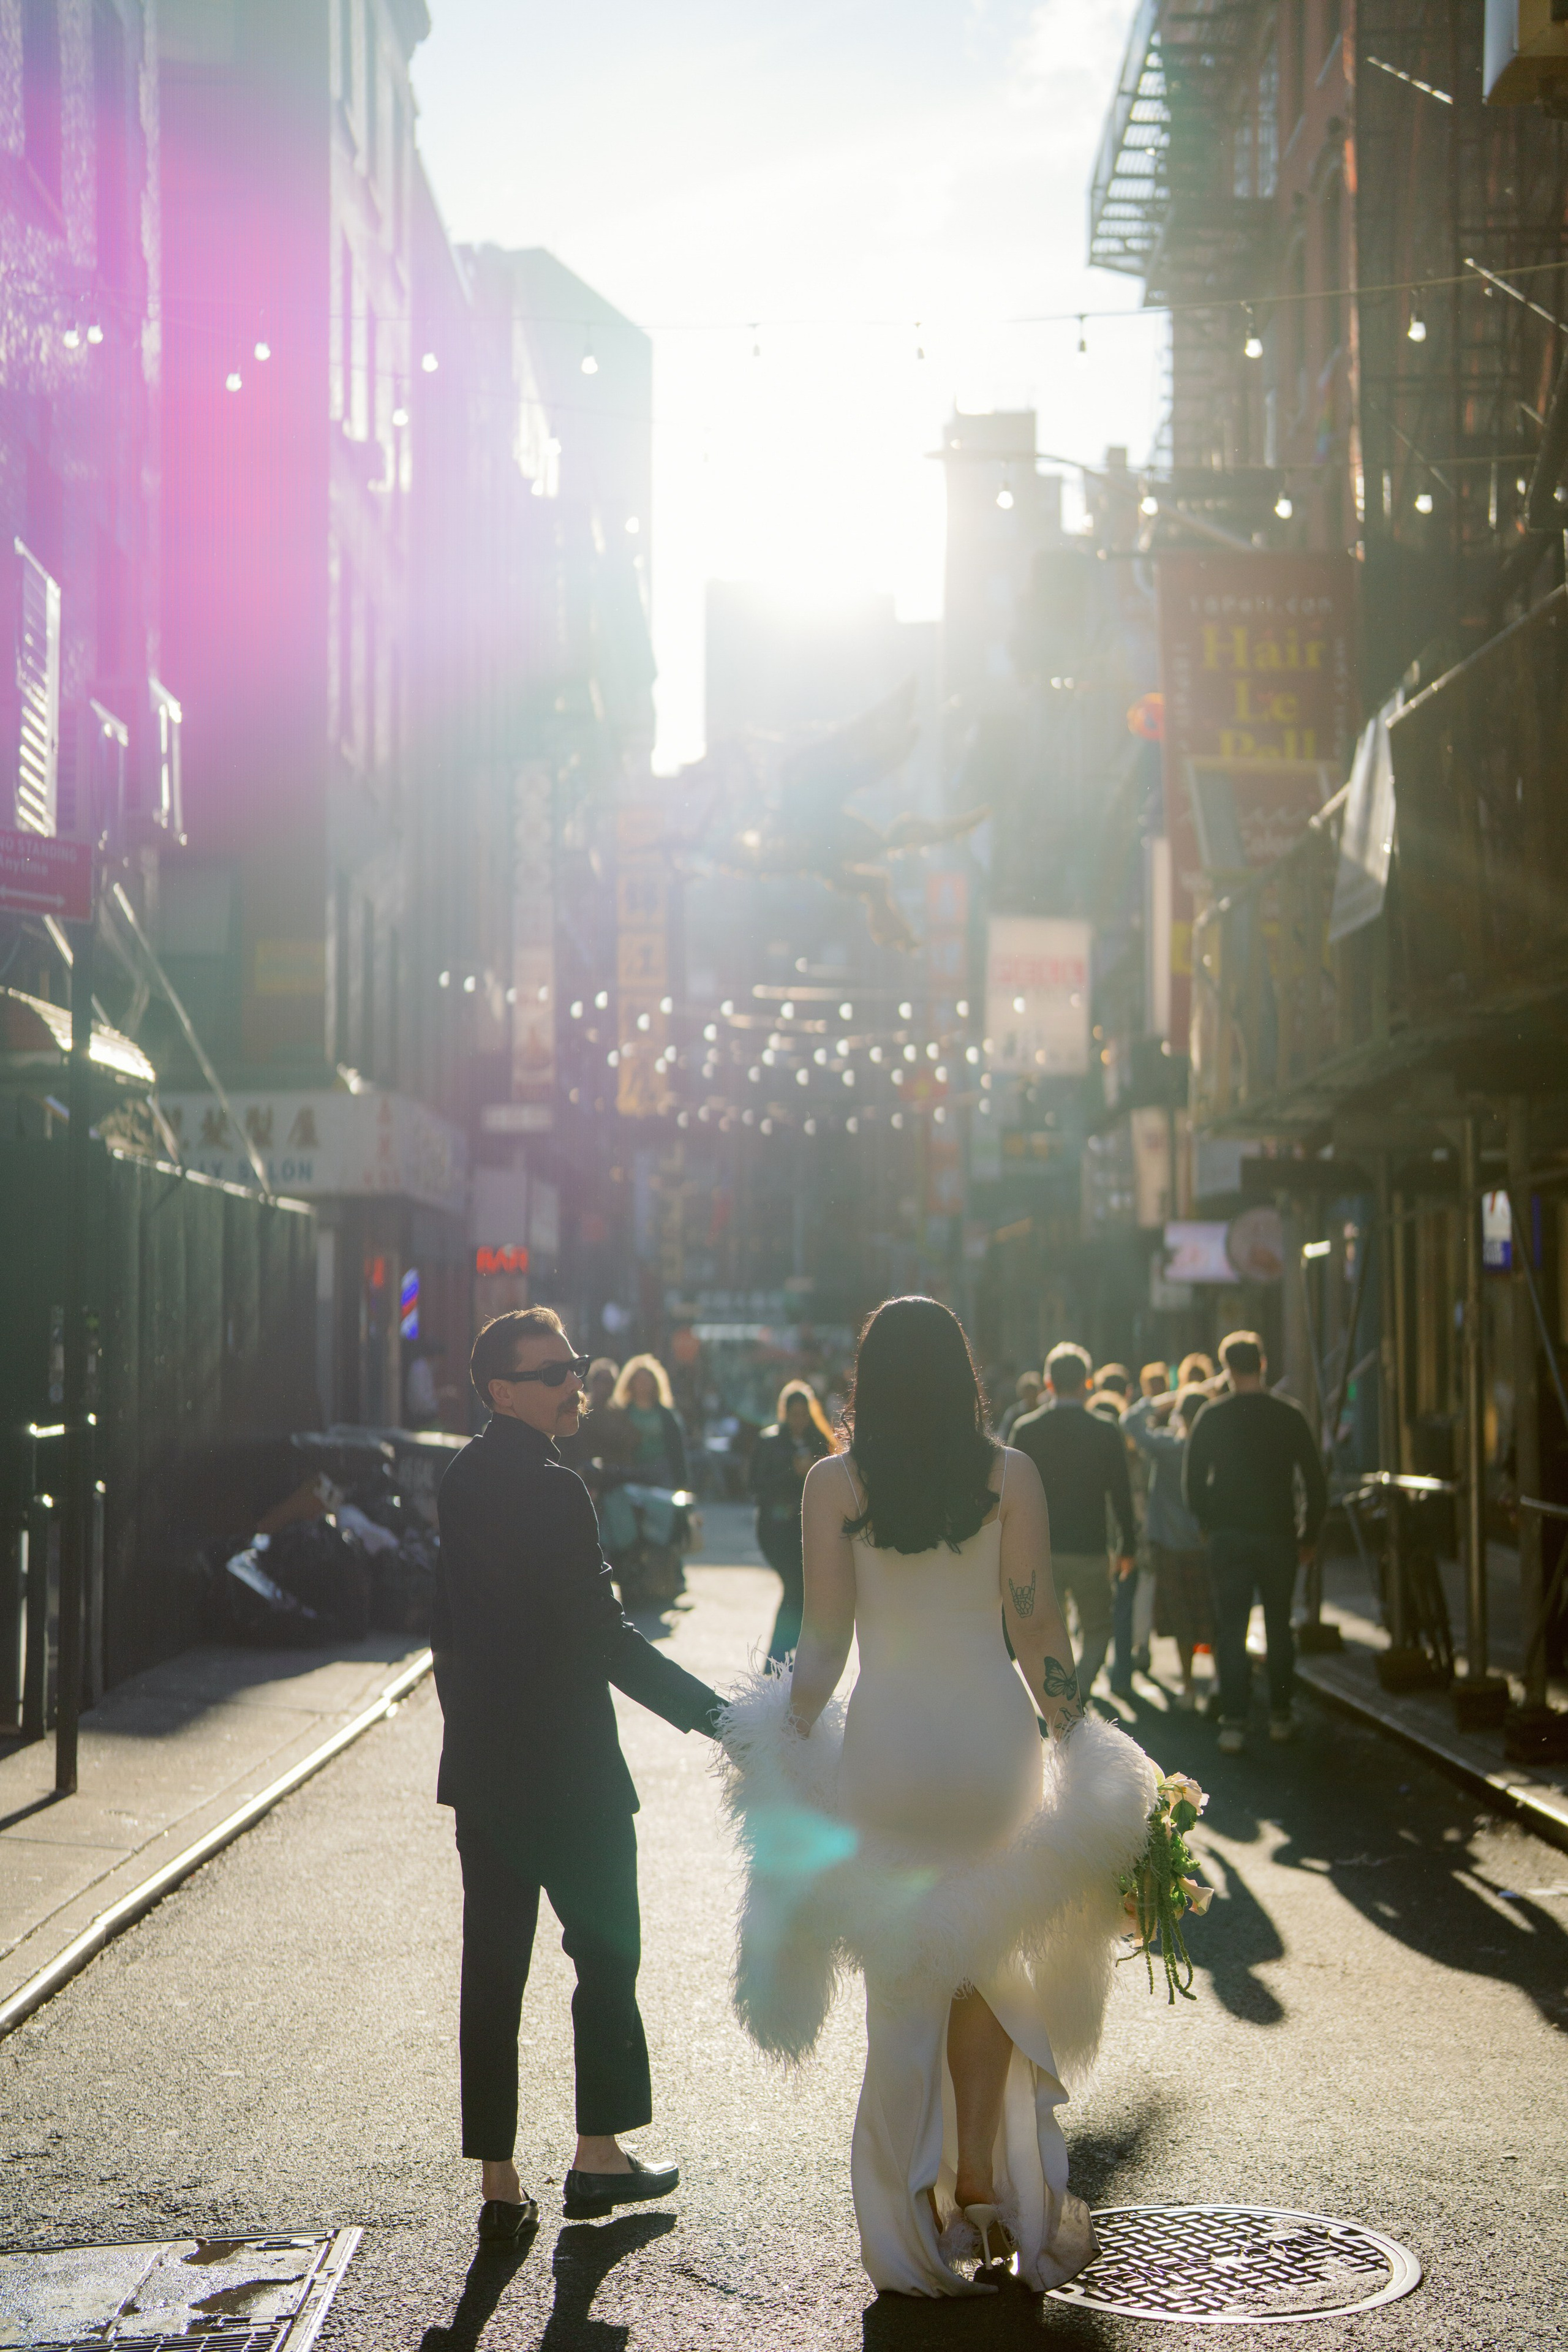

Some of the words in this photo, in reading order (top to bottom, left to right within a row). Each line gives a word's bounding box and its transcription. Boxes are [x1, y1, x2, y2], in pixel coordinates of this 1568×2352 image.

[1202, 625, 1326, 672] Hair
[1233, 676, 1299, 724] Le
[17, 837, 77, 864] STANDING
[238, 1160, 313, 1183] SLON
[1087, 2256, 1218, 2287] SEWER
